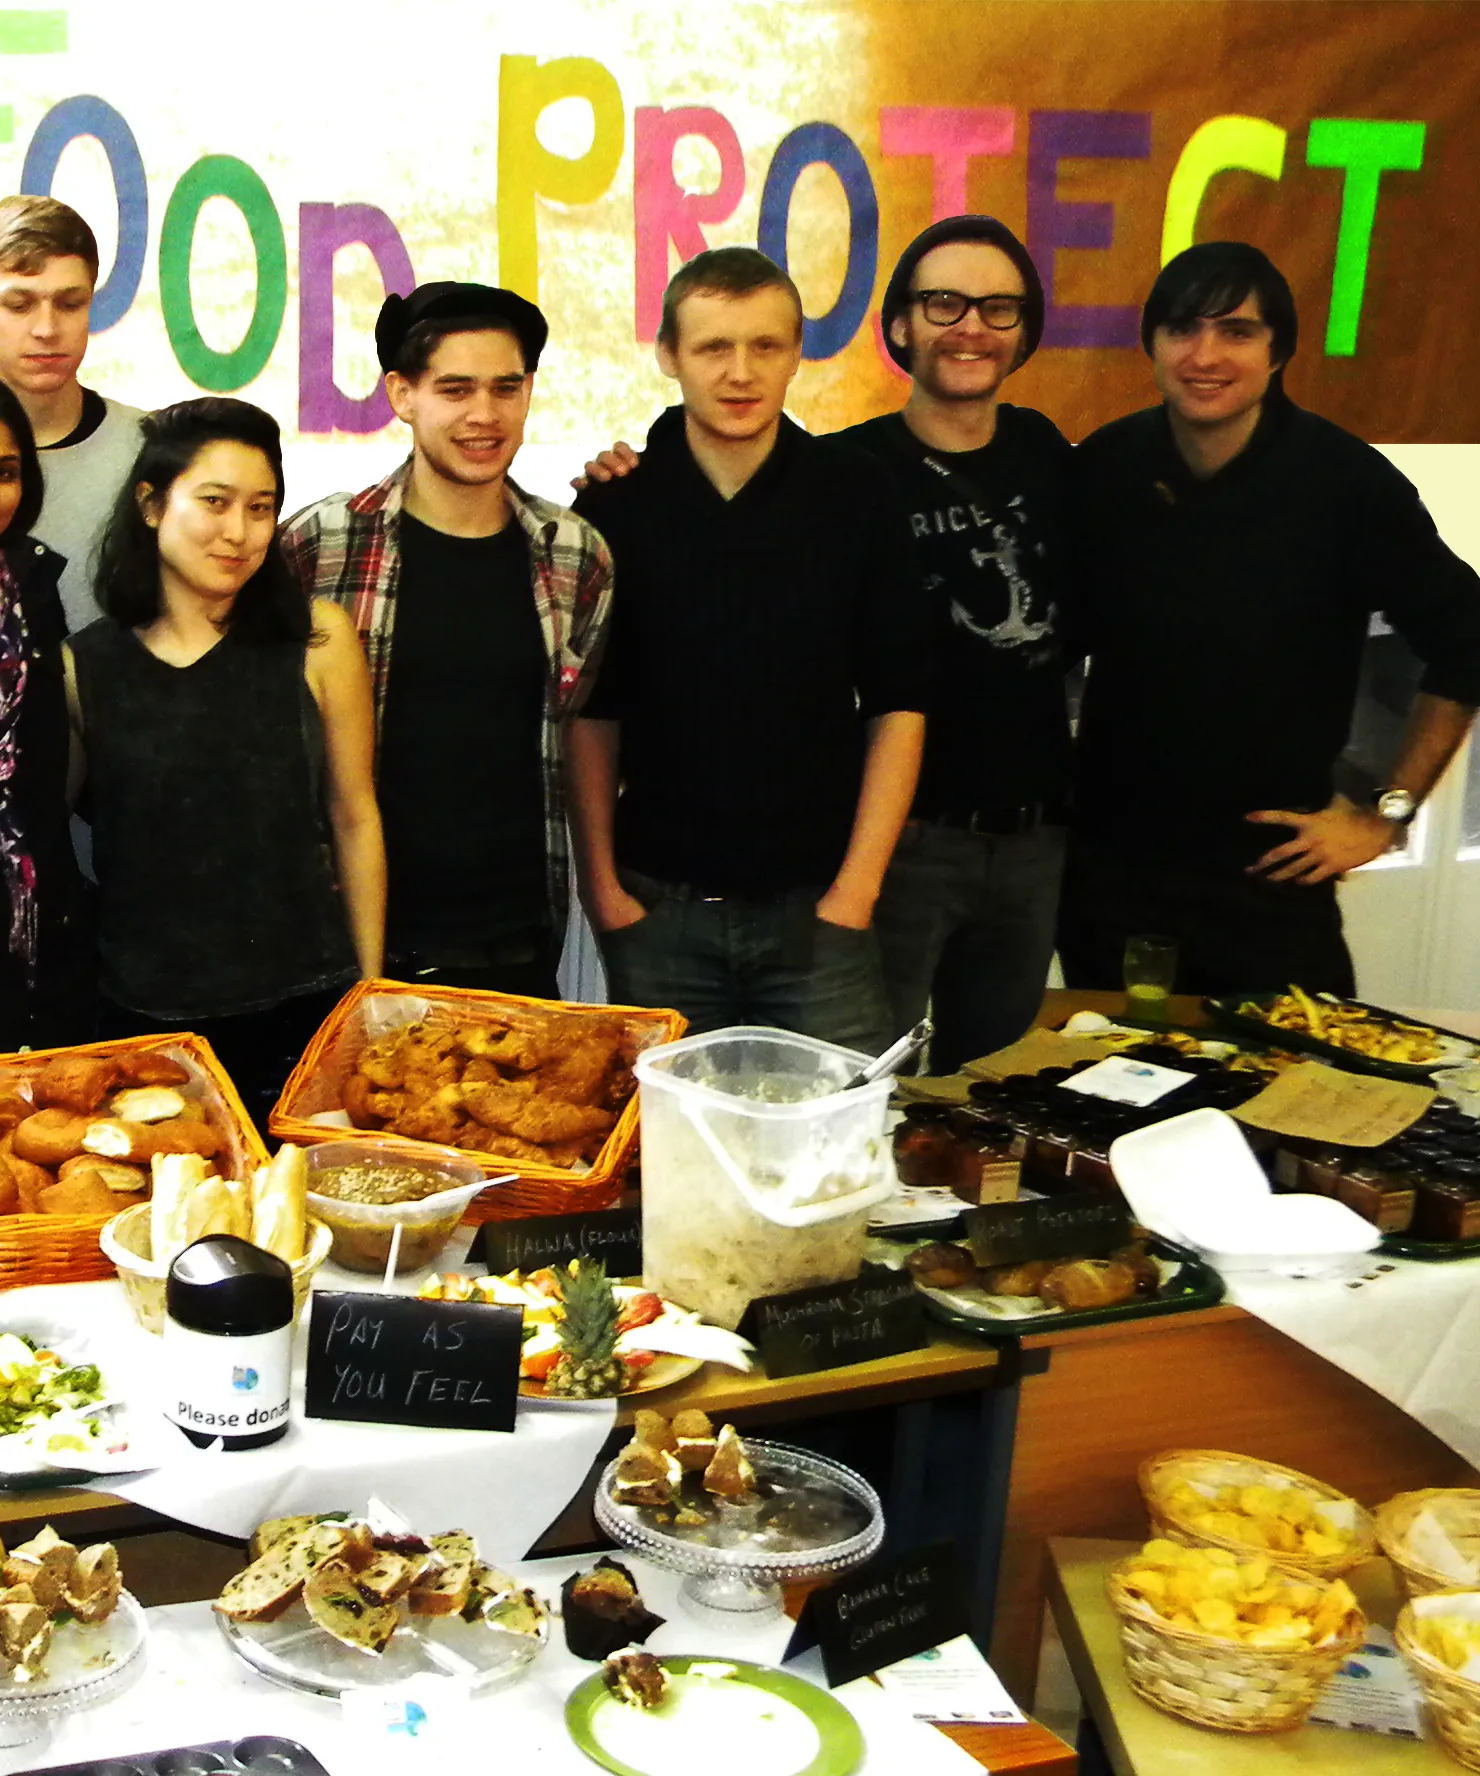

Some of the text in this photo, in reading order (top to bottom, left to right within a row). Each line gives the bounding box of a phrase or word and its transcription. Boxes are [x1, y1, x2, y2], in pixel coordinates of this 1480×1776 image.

[505, 1231, 576, 1265] HALWA
[324, 1301, 468, 1355] PAY AS
[332, 1363, 493, 1406] YOU FEEL
[178, 1400, 240, 1428] Please
